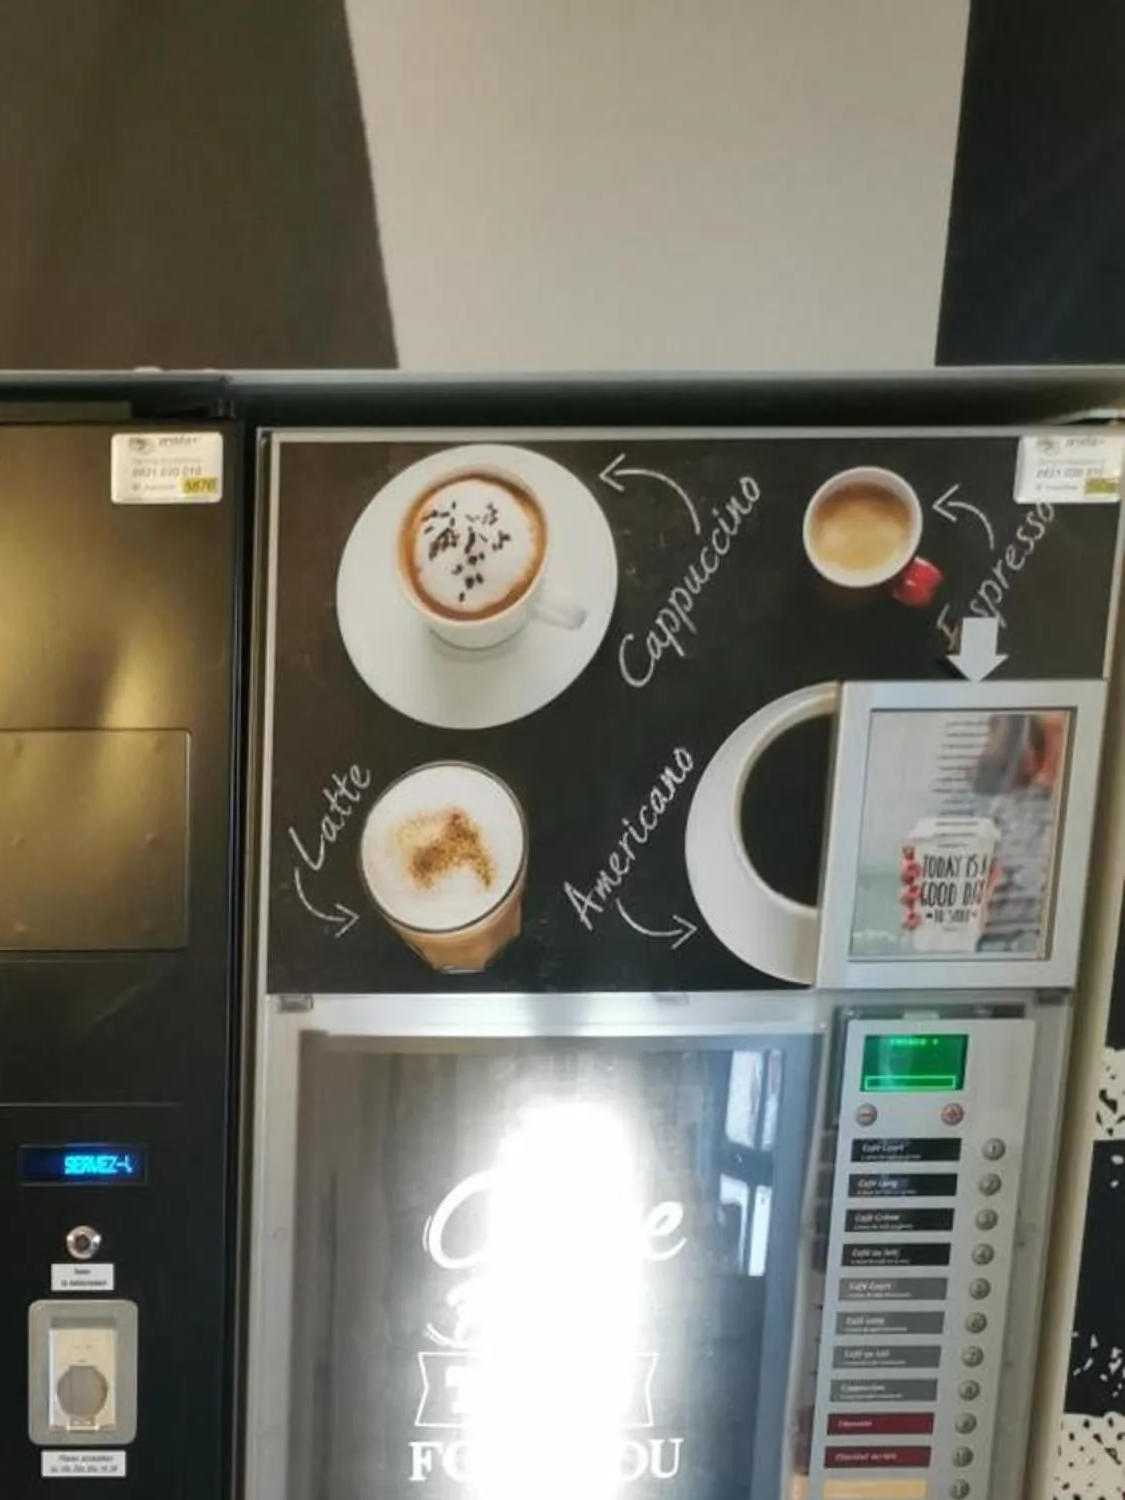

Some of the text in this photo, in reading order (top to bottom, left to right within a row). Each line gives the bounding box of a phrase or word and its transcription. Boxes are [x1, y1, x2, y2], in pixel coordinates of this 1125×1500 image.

[618, 475, 762, 688] Cappuccino
[289, 763, 371, 870] Latte
[563, 745, 695, 931] Americano
